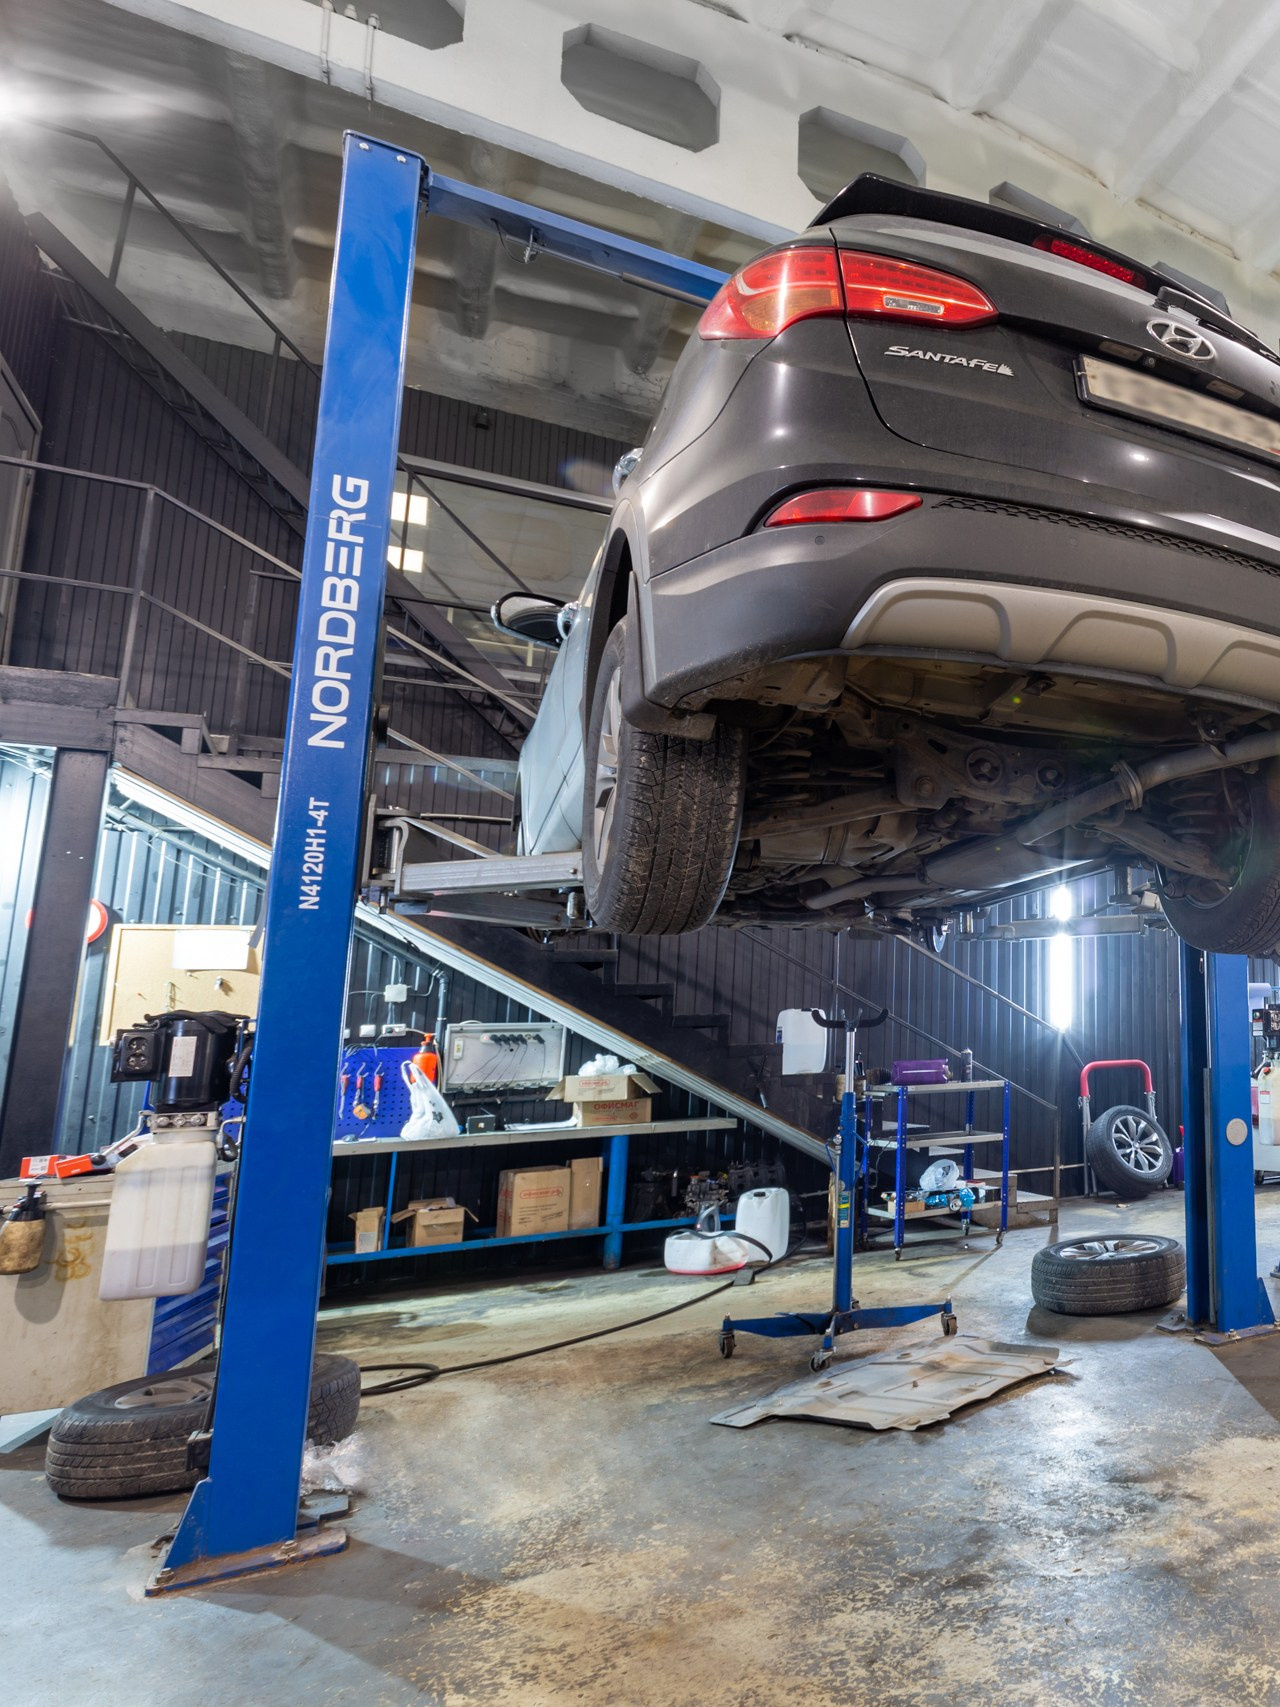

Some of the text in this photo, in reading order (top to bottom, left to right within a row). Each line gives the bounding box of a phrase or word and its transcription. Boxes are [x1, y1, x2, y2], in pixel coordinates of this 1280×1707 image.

[307, 474, 370, 749] NORDBERG
[298, 796, 330, 911] N4120H1-4T
[593, 1100, 641, 1111] ОФИСМАГ
